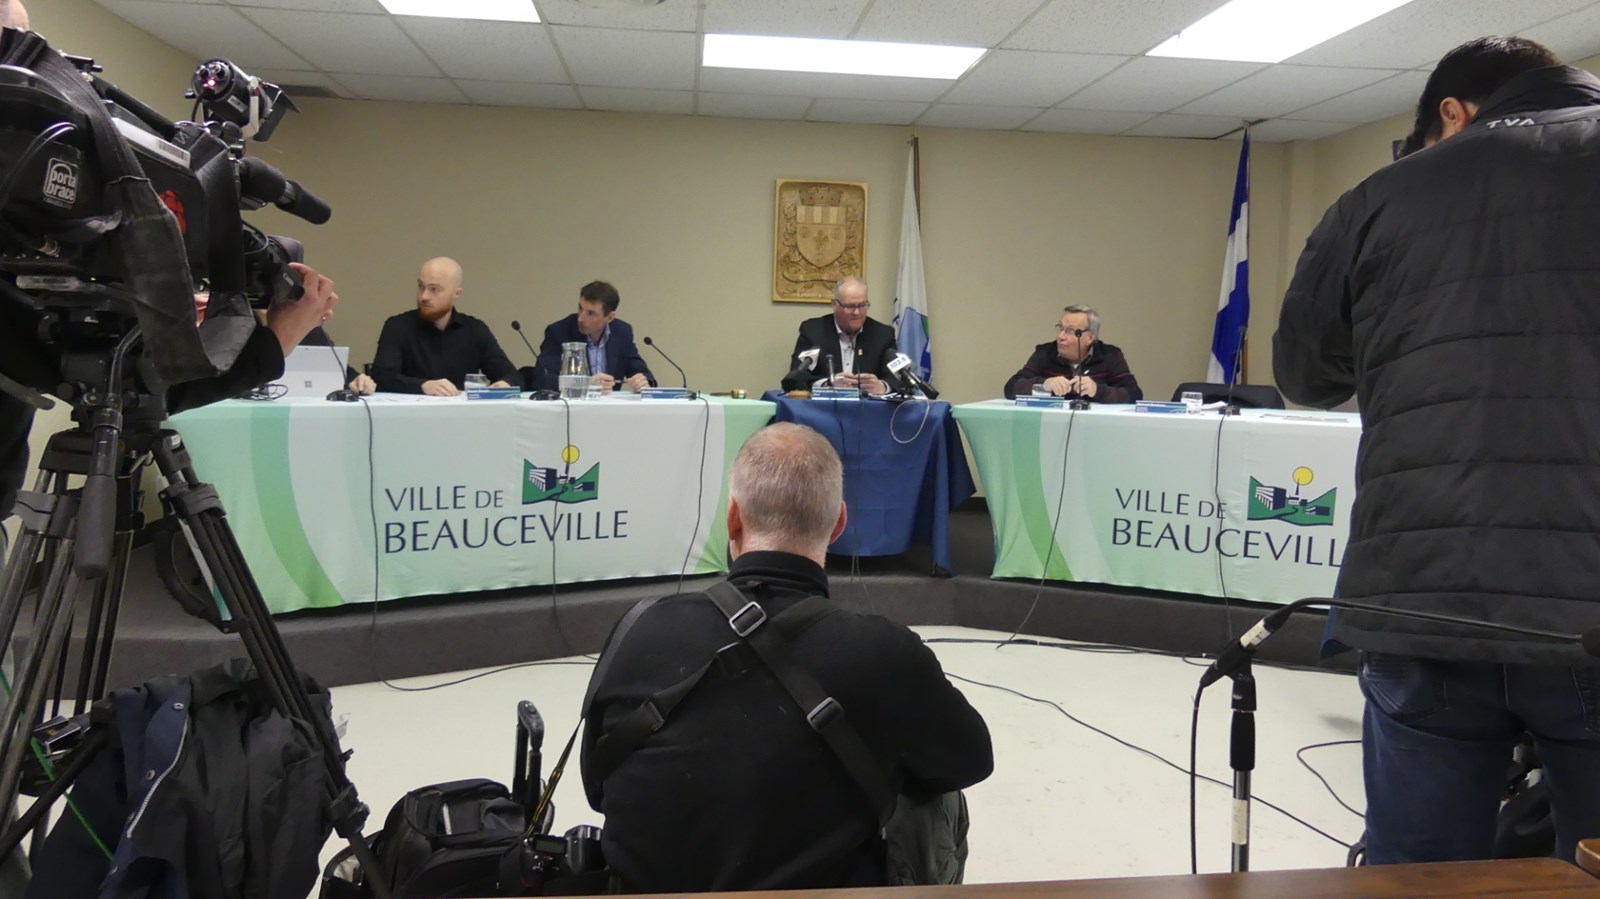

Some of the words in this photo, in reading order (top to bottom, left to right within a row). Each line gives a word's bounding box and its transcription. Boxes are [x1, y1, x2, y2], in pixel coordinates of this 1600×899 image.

[1486, 118, 1535, 129] TVA
[46, 182, 76, 201] brace
[50, 168, 77, 188] porta
[385, 485, 466, 512] VILLE
[475, 490, 504, 509] DE
[1115, 488, 1190, 516] VILLE
[1198, 500, 1227, 520] DE
[384, 510, 629, 554] BEAUCEVILLE
[1112, 517, 1342, 568] BEAUCEVILL
